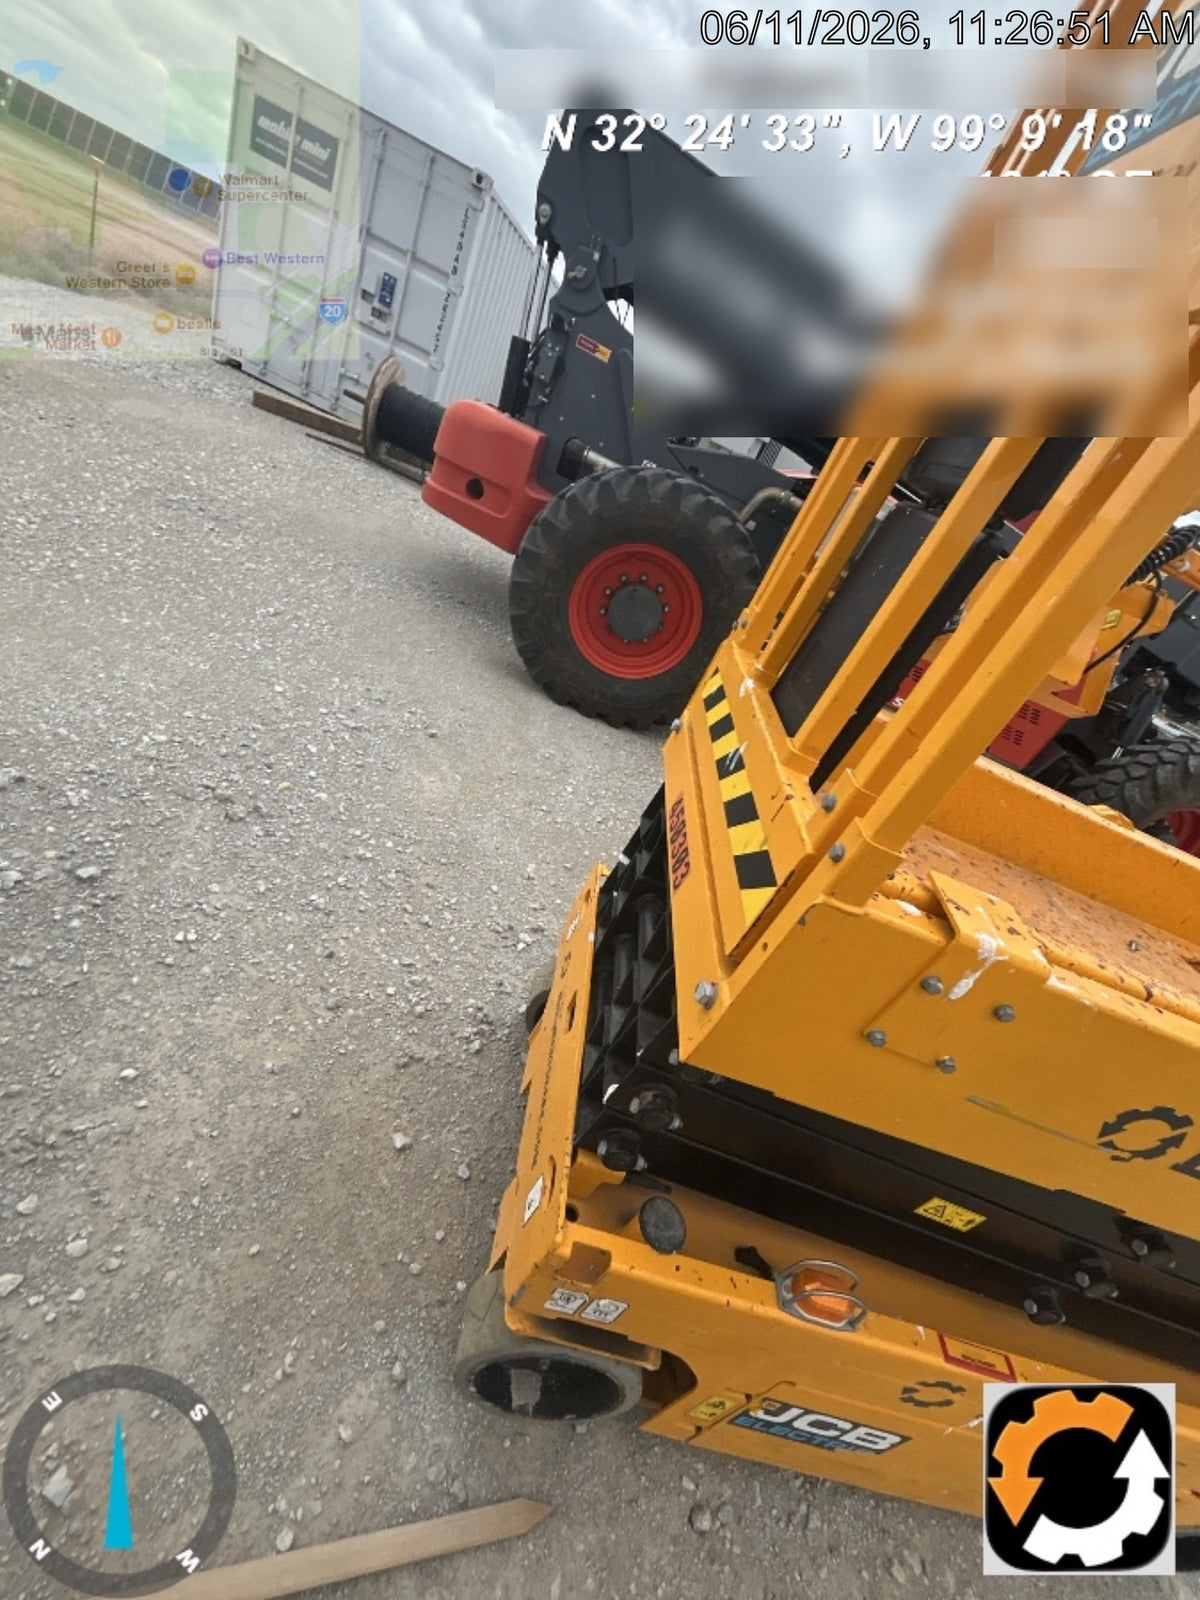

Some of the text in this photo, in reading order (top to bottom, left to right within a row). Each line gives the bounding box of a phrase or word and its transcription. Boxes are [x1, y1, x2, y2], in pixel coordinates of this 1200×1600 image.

[257, 115, 301, 145] mobie
[301, 138, 331, 161] mini
[750, 1402, 902, 1451] JCB
